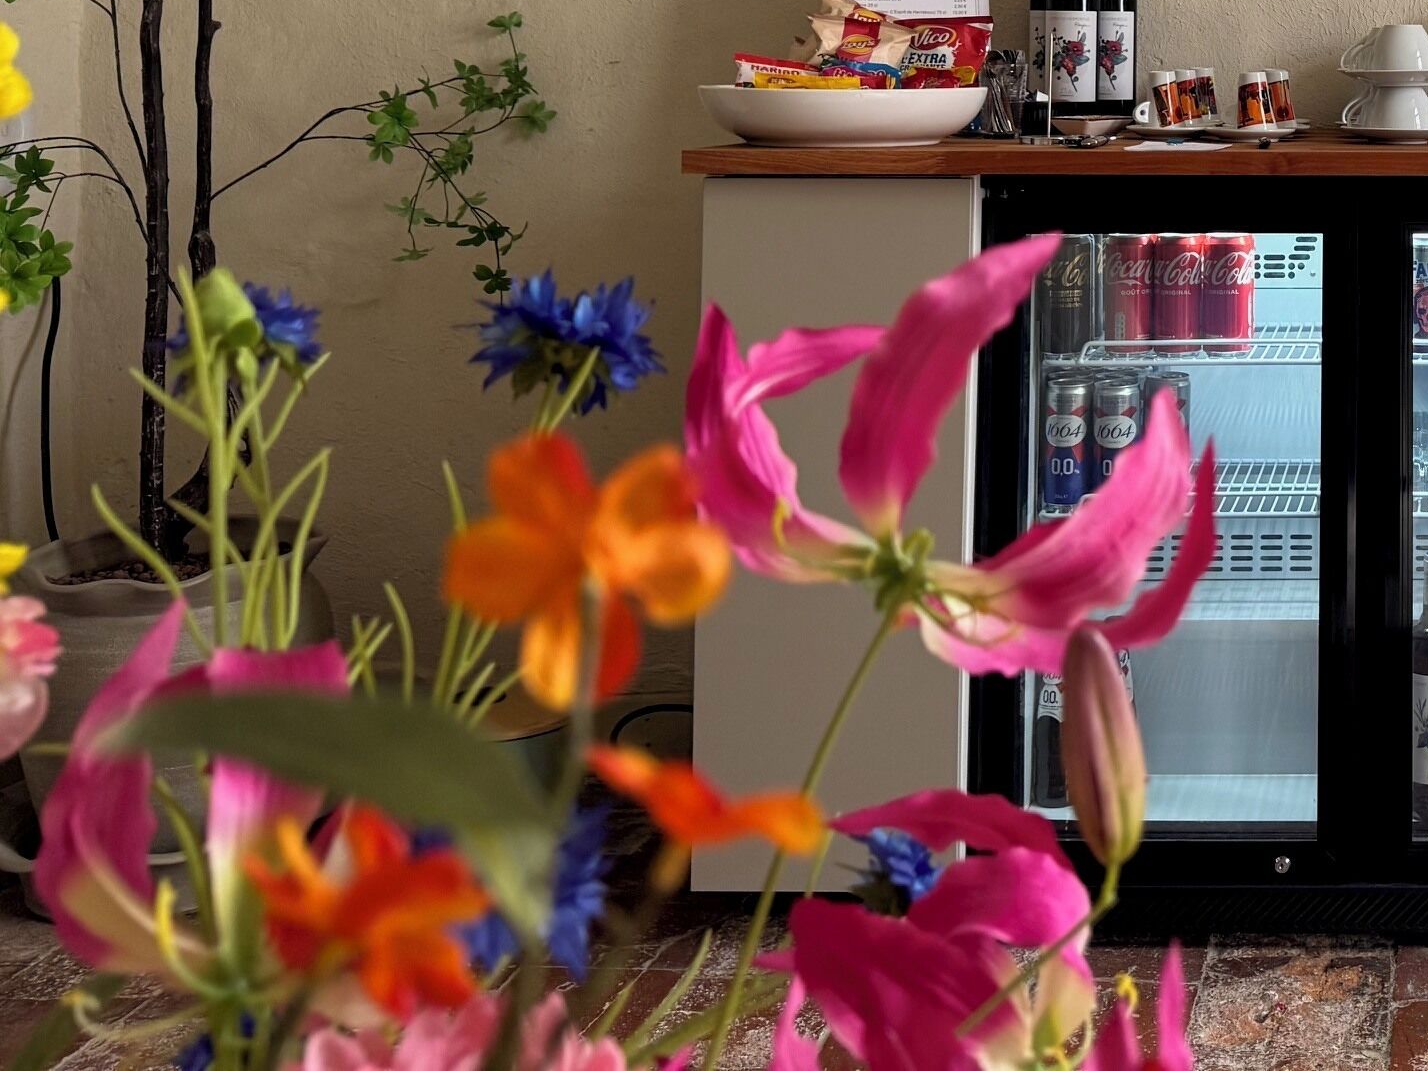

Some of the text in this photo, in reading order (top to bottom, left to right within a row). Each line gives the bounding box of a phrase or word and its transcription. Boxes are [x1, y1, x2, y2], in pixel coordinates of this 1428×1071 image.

[912, 28, 951, 47] Vico
[750, 64, 800, 76] HARIBO
[1047, 423, 1085, 438] 1664
[1097, 423, 1135, 439] 1664
